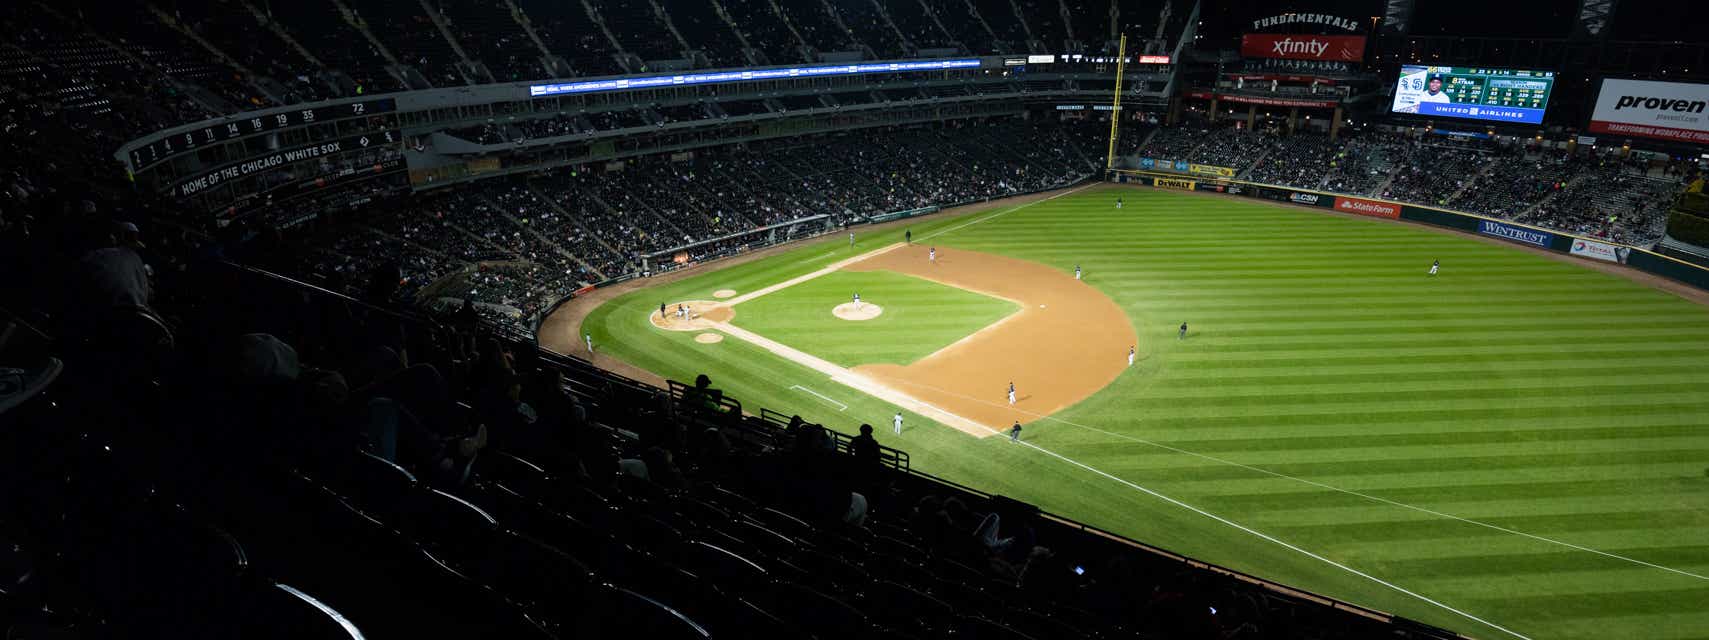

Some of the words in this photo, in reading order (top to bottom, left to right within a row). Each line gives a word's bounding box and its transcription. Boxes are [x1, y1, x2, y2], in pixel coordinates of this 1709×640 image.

[1253, 13, 1359, 32] FUNDAMENTALS
[1272, 37, 1329, 56] xfinity
[352, 103, 364, 113] 72
[1615, 95, 1706, 113] proven
[302, 109, 314, 120] 35
[1436, 106, 1469, 114] UNITED
[1480, 110, 1523, 118] AIRLINES
[251, 118, 262, 129] 16
[276, 114, 287, 125] 19
[205, 128, 214, 140] 11
[226, 122, 238, 134] 14
[185, 133, 193, 144] 9
[181, 176, 208, 196] HOME
[208, 172, 220, 185] OF
[219, 165, 239, 181] THE
[240, 153, 283, 175] CHICAGO
[284, 147, 319, 163] WHITE
[320, 141, 342, 155] SOX
[1300, 194, 1319, 203] CSN
[1353, 202, 1373, 212] State
[1373, 204, 1394, 214] Farm
[1485, 221, 1545, 244] WINTRUST
